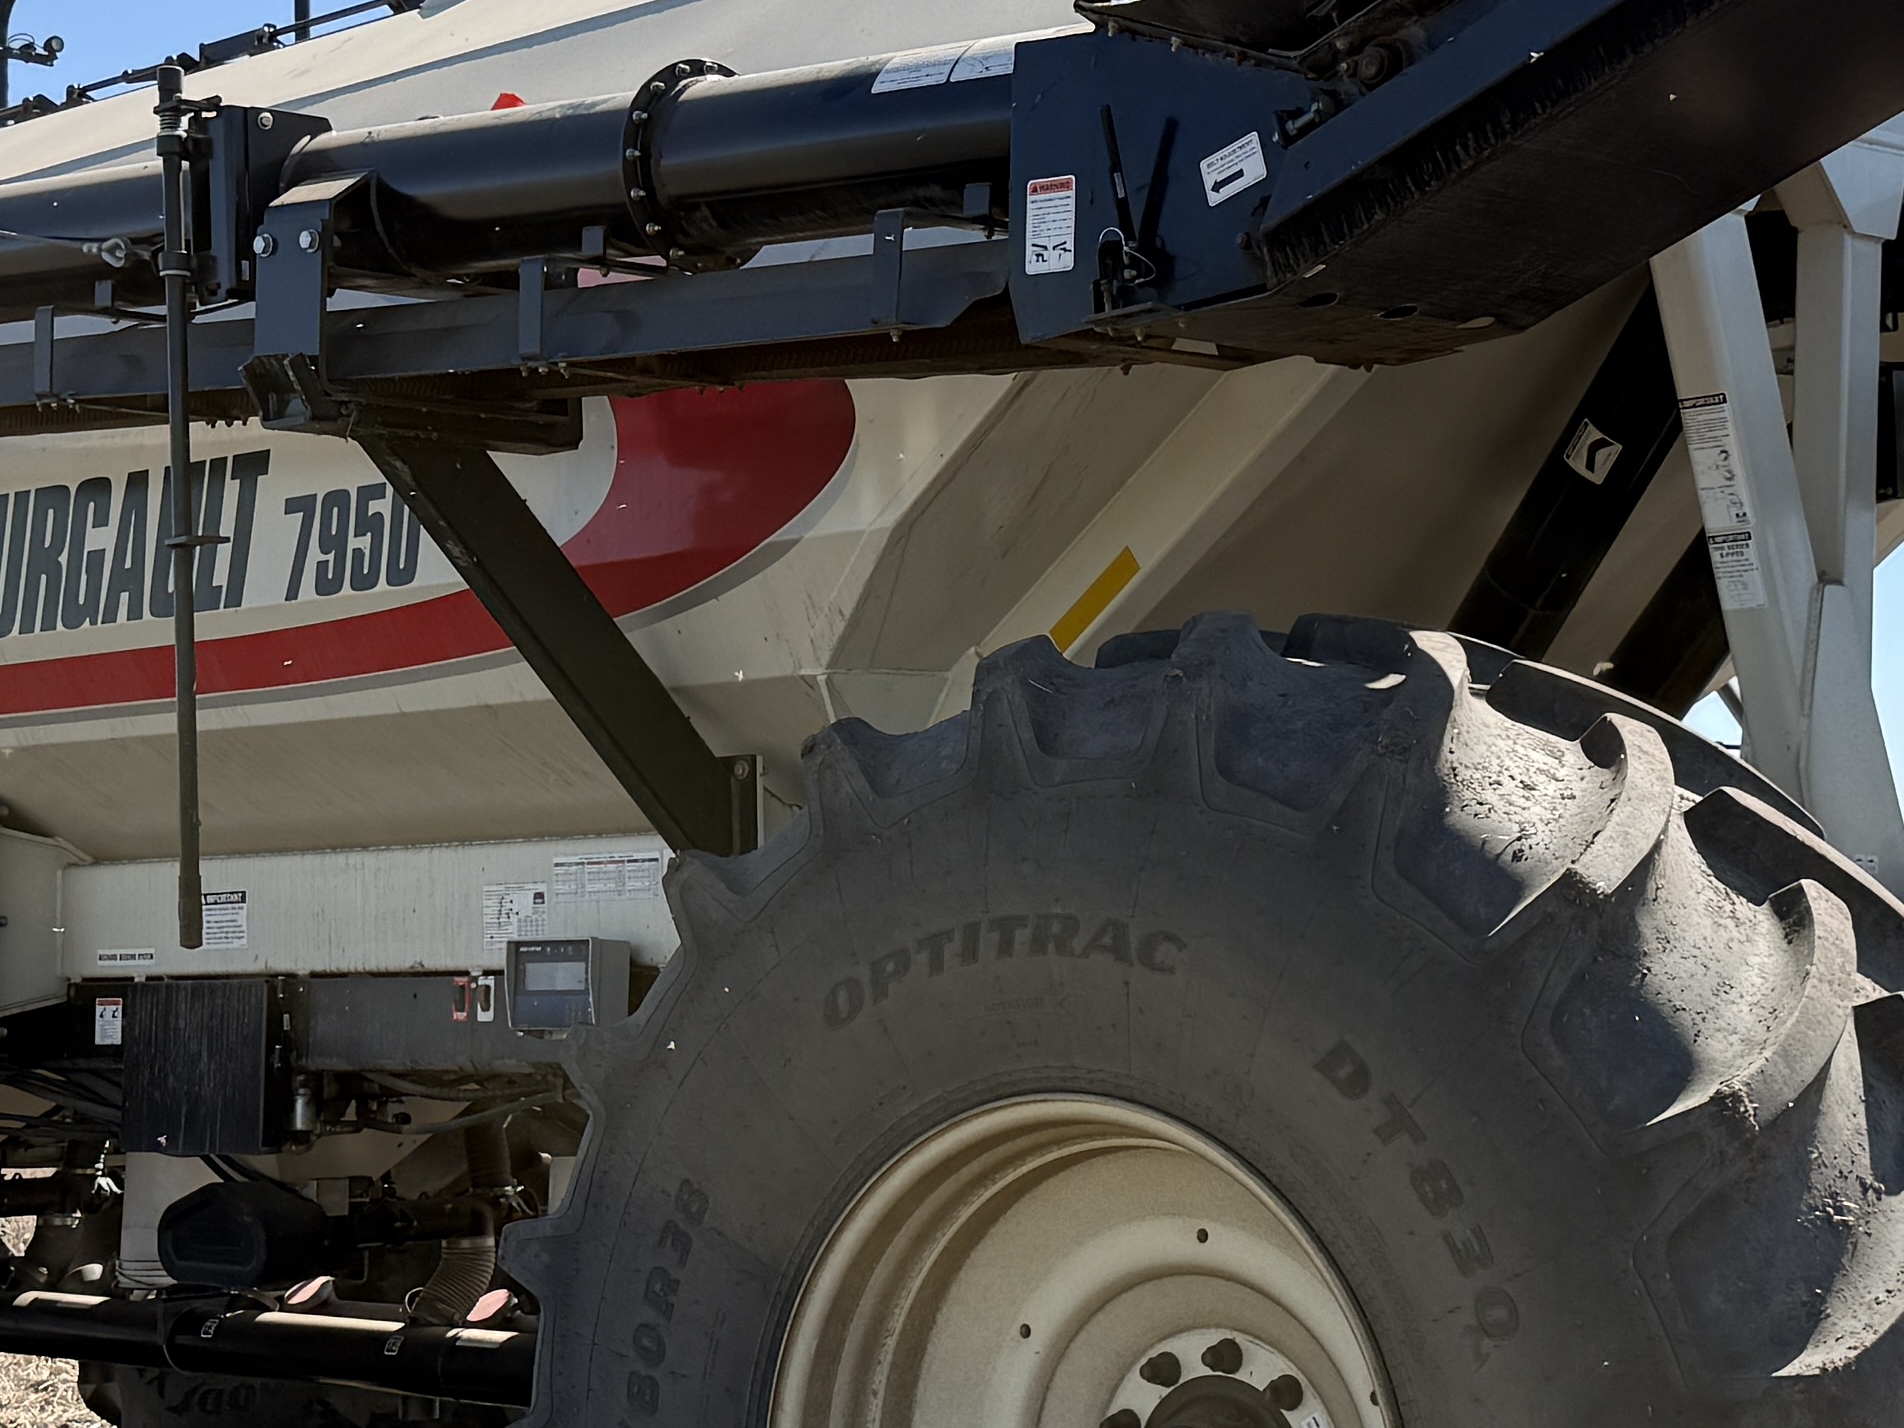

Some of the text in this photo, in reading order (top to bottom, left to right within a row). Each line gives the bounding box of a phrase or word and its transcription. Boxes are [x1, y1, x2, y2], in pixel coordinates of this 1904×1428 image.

[284, 482, 422, 602] 7950
[821, 912, 1189, 1031] OPTITRAC
[1312, 1037, 1523, 1345] DT830
